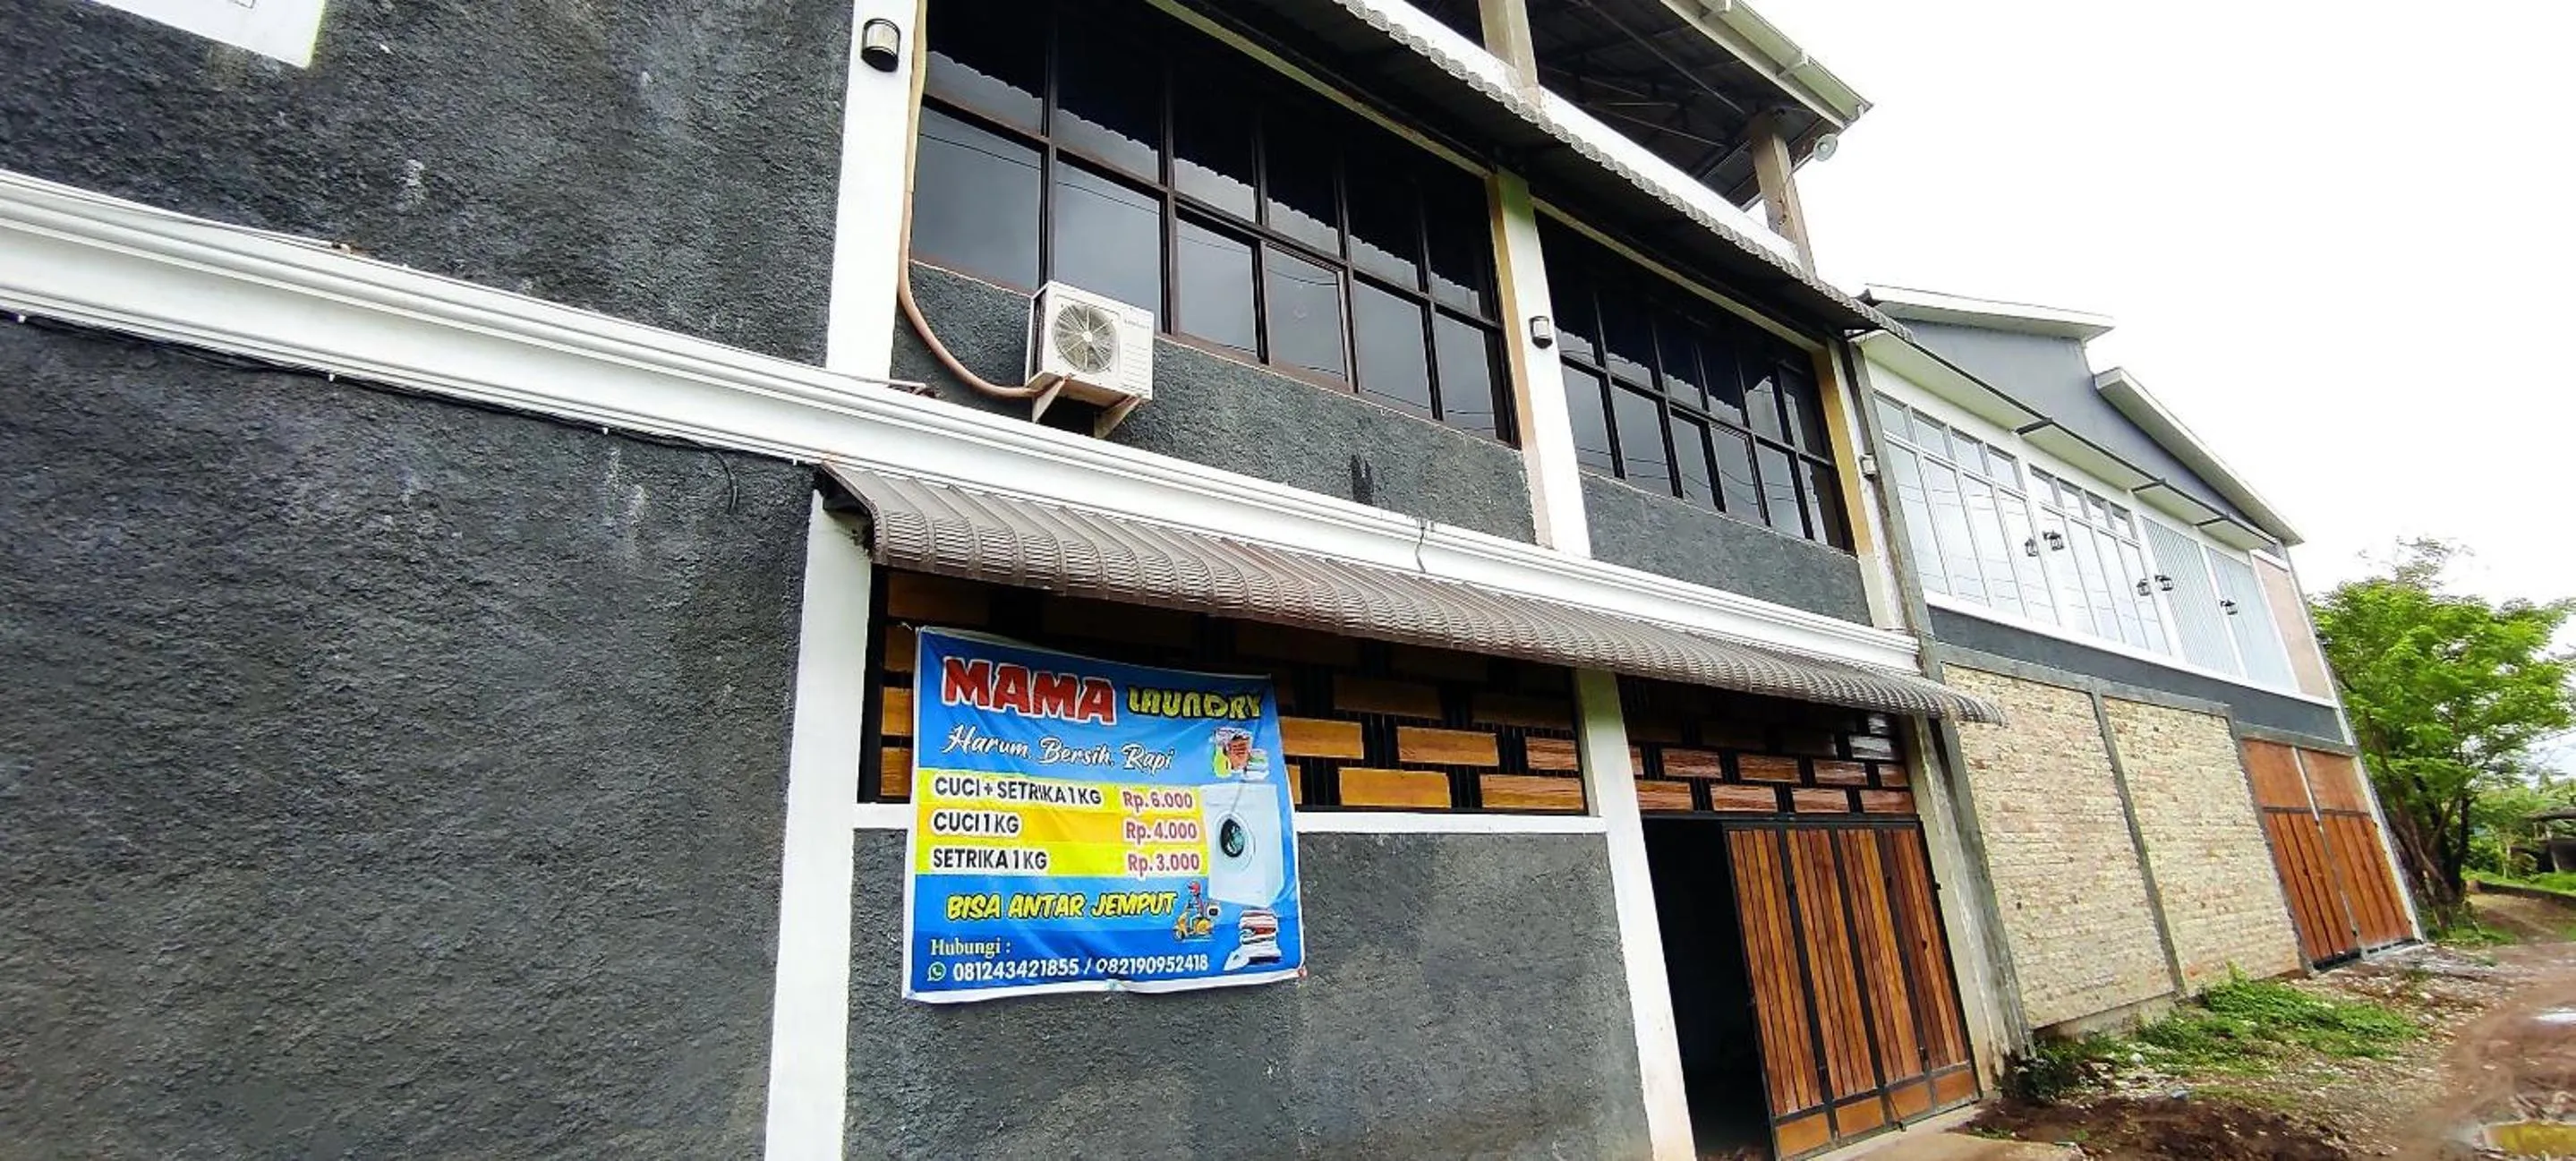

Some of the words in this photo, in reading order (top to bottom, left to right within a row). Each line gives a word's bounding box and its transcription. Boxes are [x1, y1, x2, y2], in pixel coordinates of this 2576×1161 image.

[943, 656, 1117, 726] MAMA
[1128, 687, 1262, 721] LAUNDRY
[1122, 742, 1175, 776] Rapi
[935, 777, 980, 797] CUCI
[984, 782, 994, 796] +
[947, 893, 1002, 920] BISA
[1009, 893, 1086, 920] ANTAR
[1091, 892, 1177, 918] JEMPUT
[930, 937, 1001, 959] Hubungi
[953, 958, 1079, 982] 081243421855
[1083, 957, 1092, 975] /
[1096, 953, 1208, 974] 082190952418
